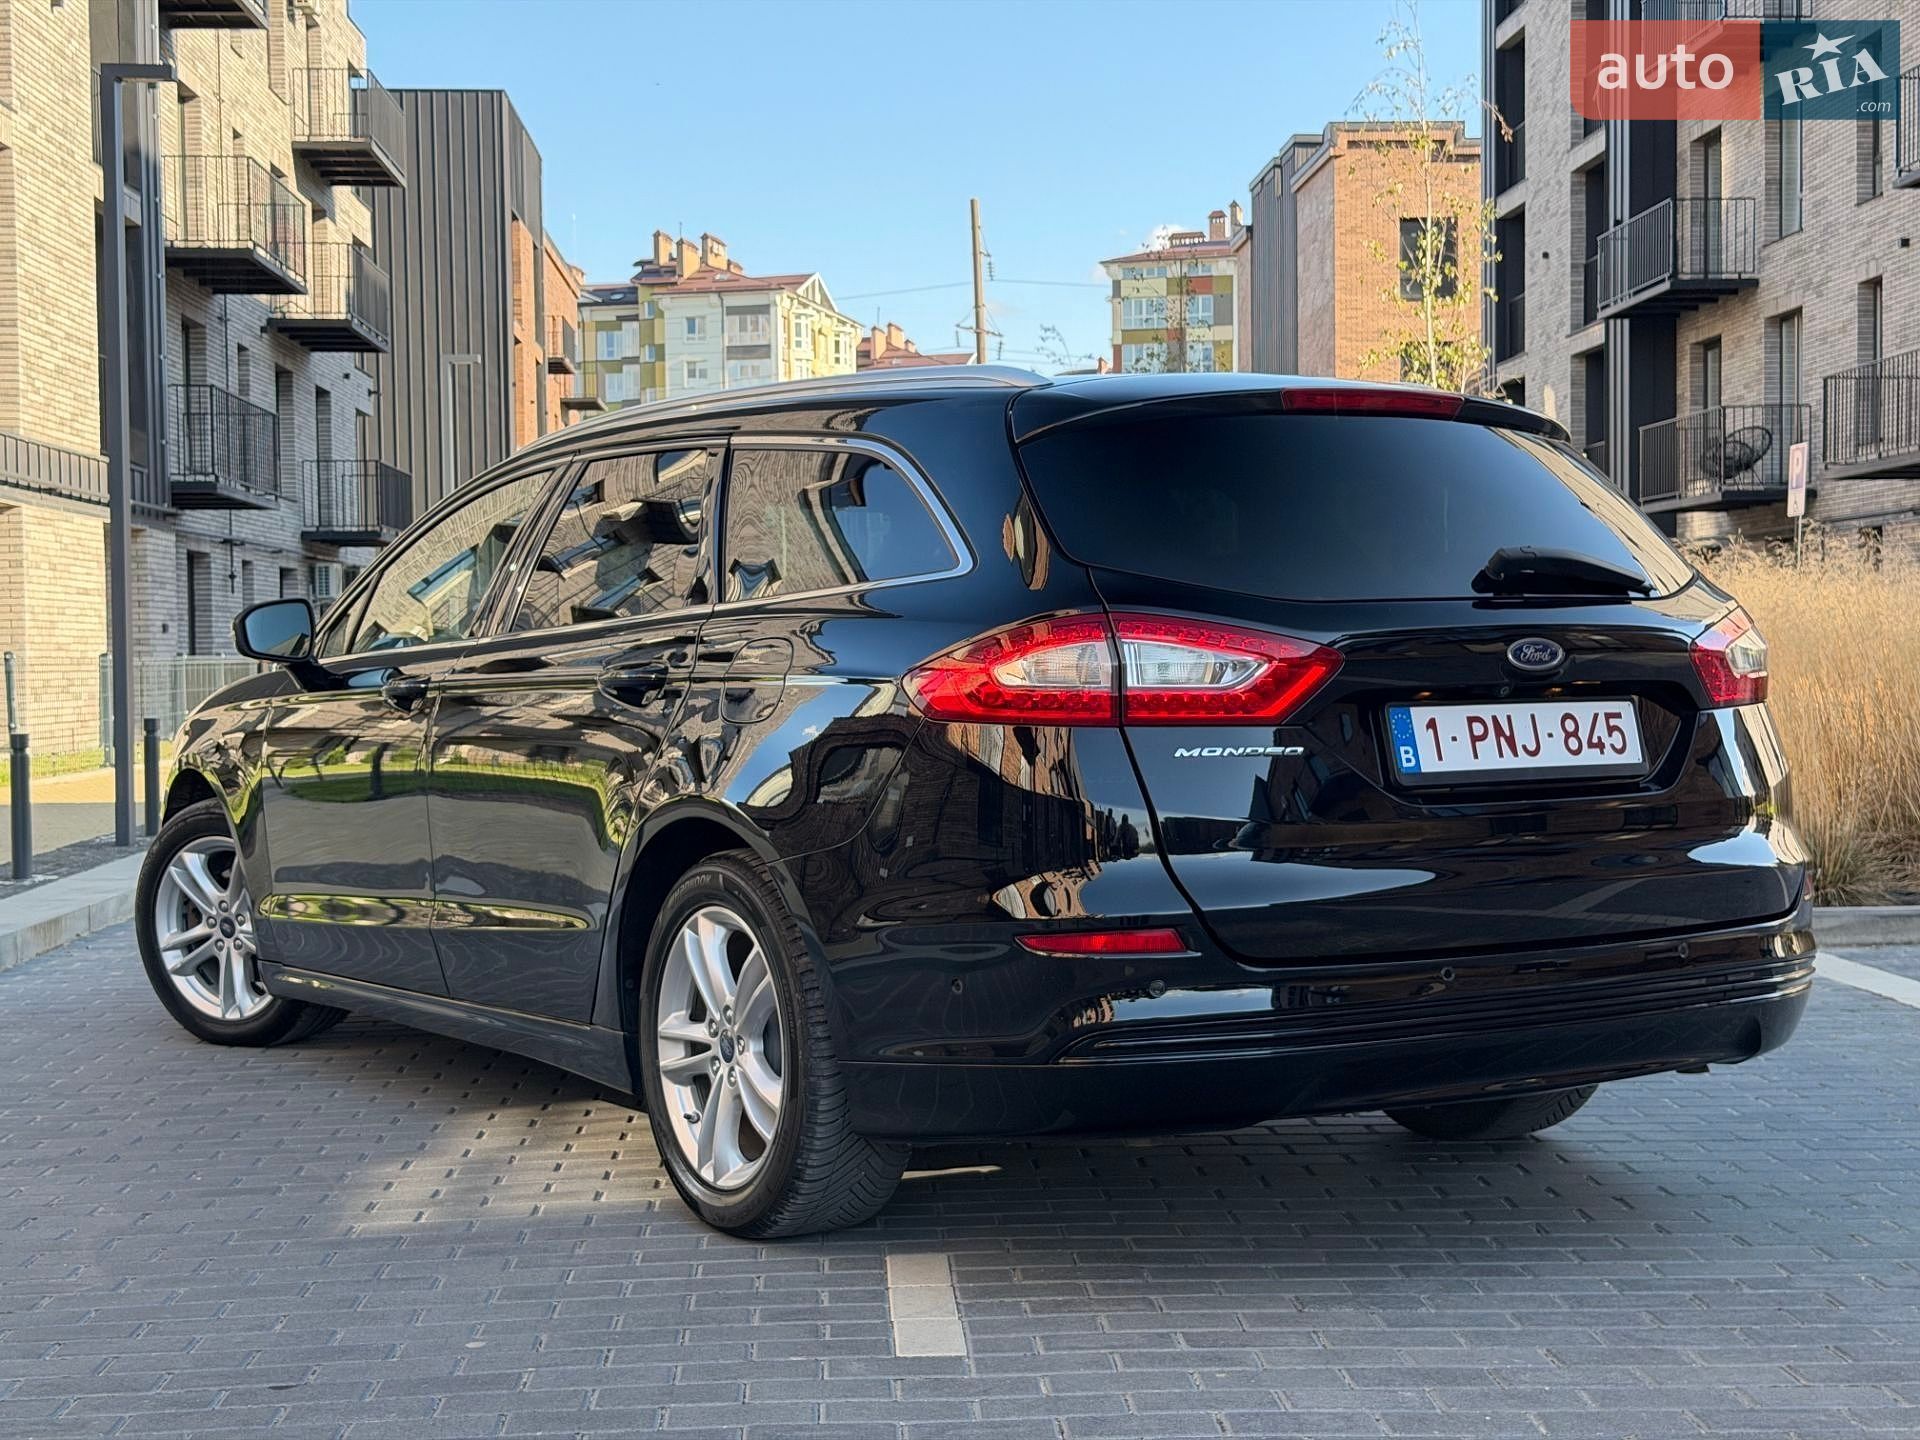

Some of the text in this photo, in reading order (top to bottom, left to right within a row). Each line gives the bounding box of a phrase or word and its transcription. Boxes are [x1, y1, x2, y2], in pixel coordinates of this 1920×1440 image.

[1791, 448, 1803, 489] P
[1520, 644, 1551, 662] Ford
[1174, 746, 1305, 758] MONDEO
[1399, 745, 1417, 768] B
